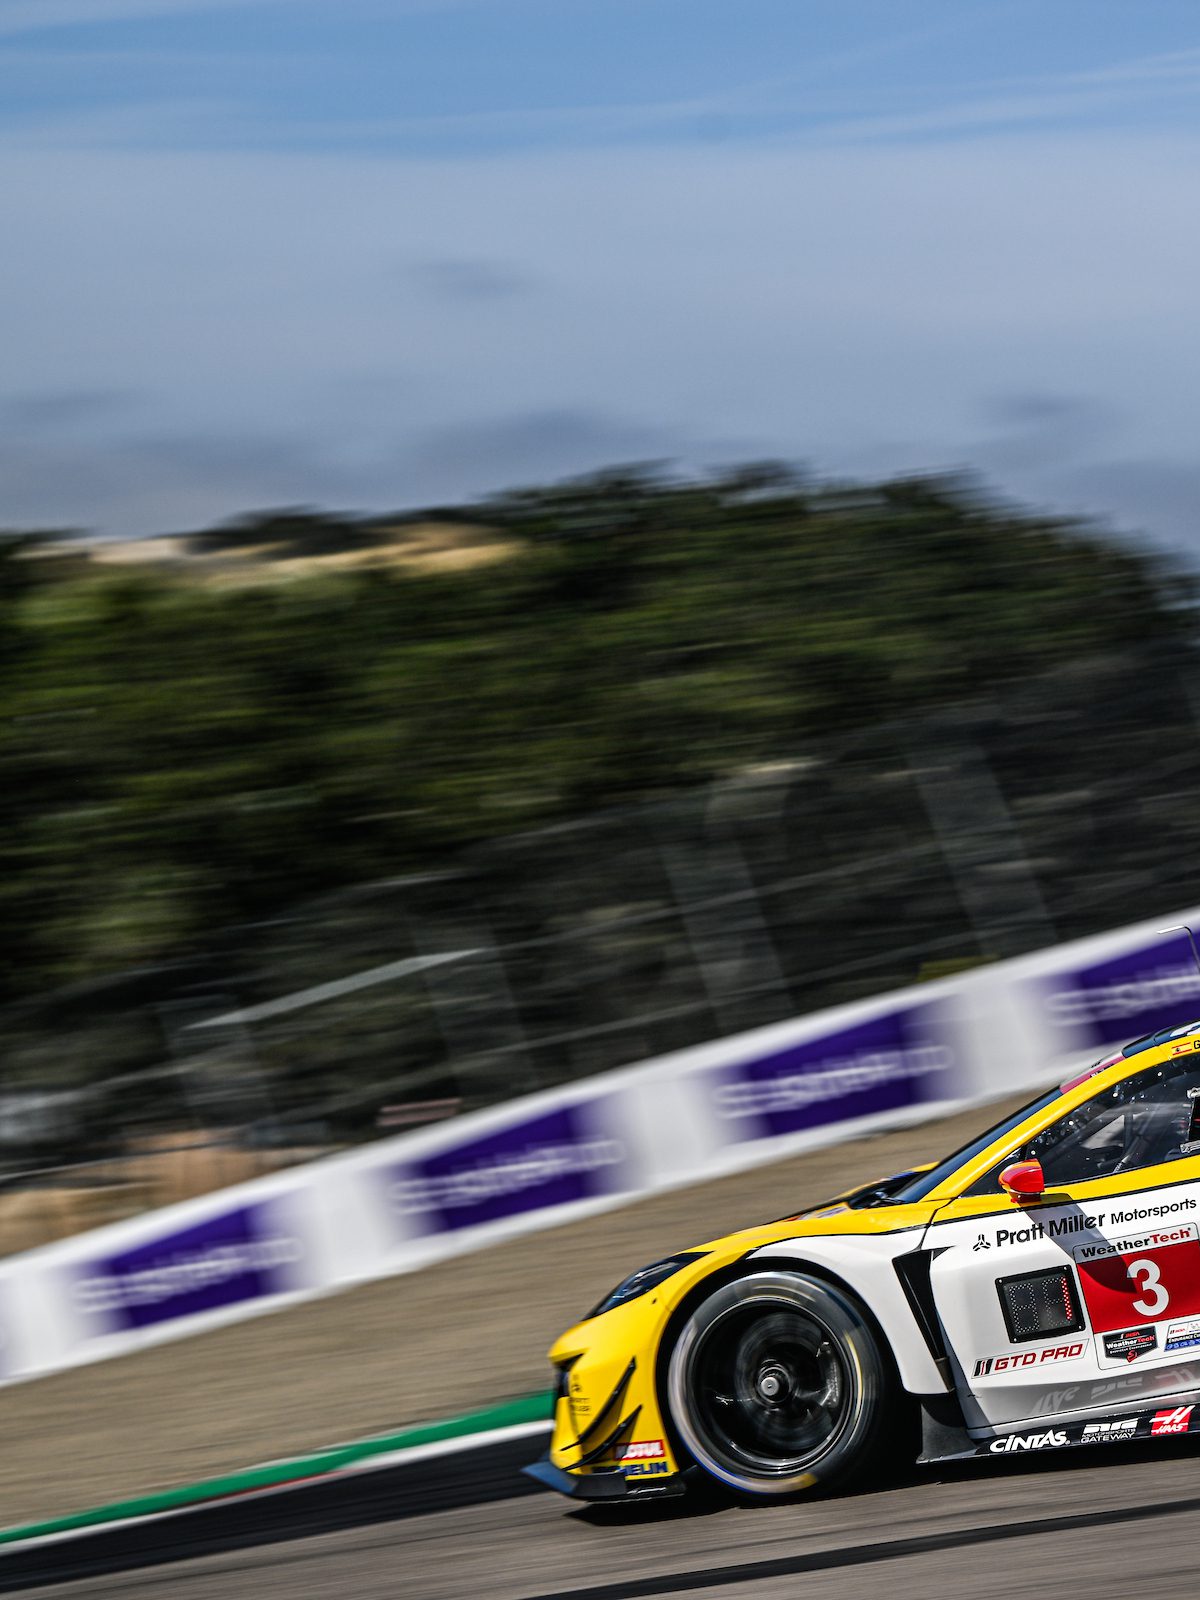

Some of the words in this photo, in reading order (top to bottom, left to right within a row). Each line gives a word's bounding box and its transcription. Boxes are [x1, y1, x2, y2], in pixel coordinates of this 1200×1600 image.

[996, 1223, 1045, 1248] Pratt
[1049, 1212, 1106, 1238] Miller
[1110, 1198, 1198, 1225] Motorsports
[1080, 1227, 1192, 1259] WeatherTech
[1126, 1259, 1170, 1317] 3
[994, 1353, 1036, 1371] GTD
[1040, 1343, 1084, 1362] PRO
[1080, 1432, 1136, 1444] GATEWAY
